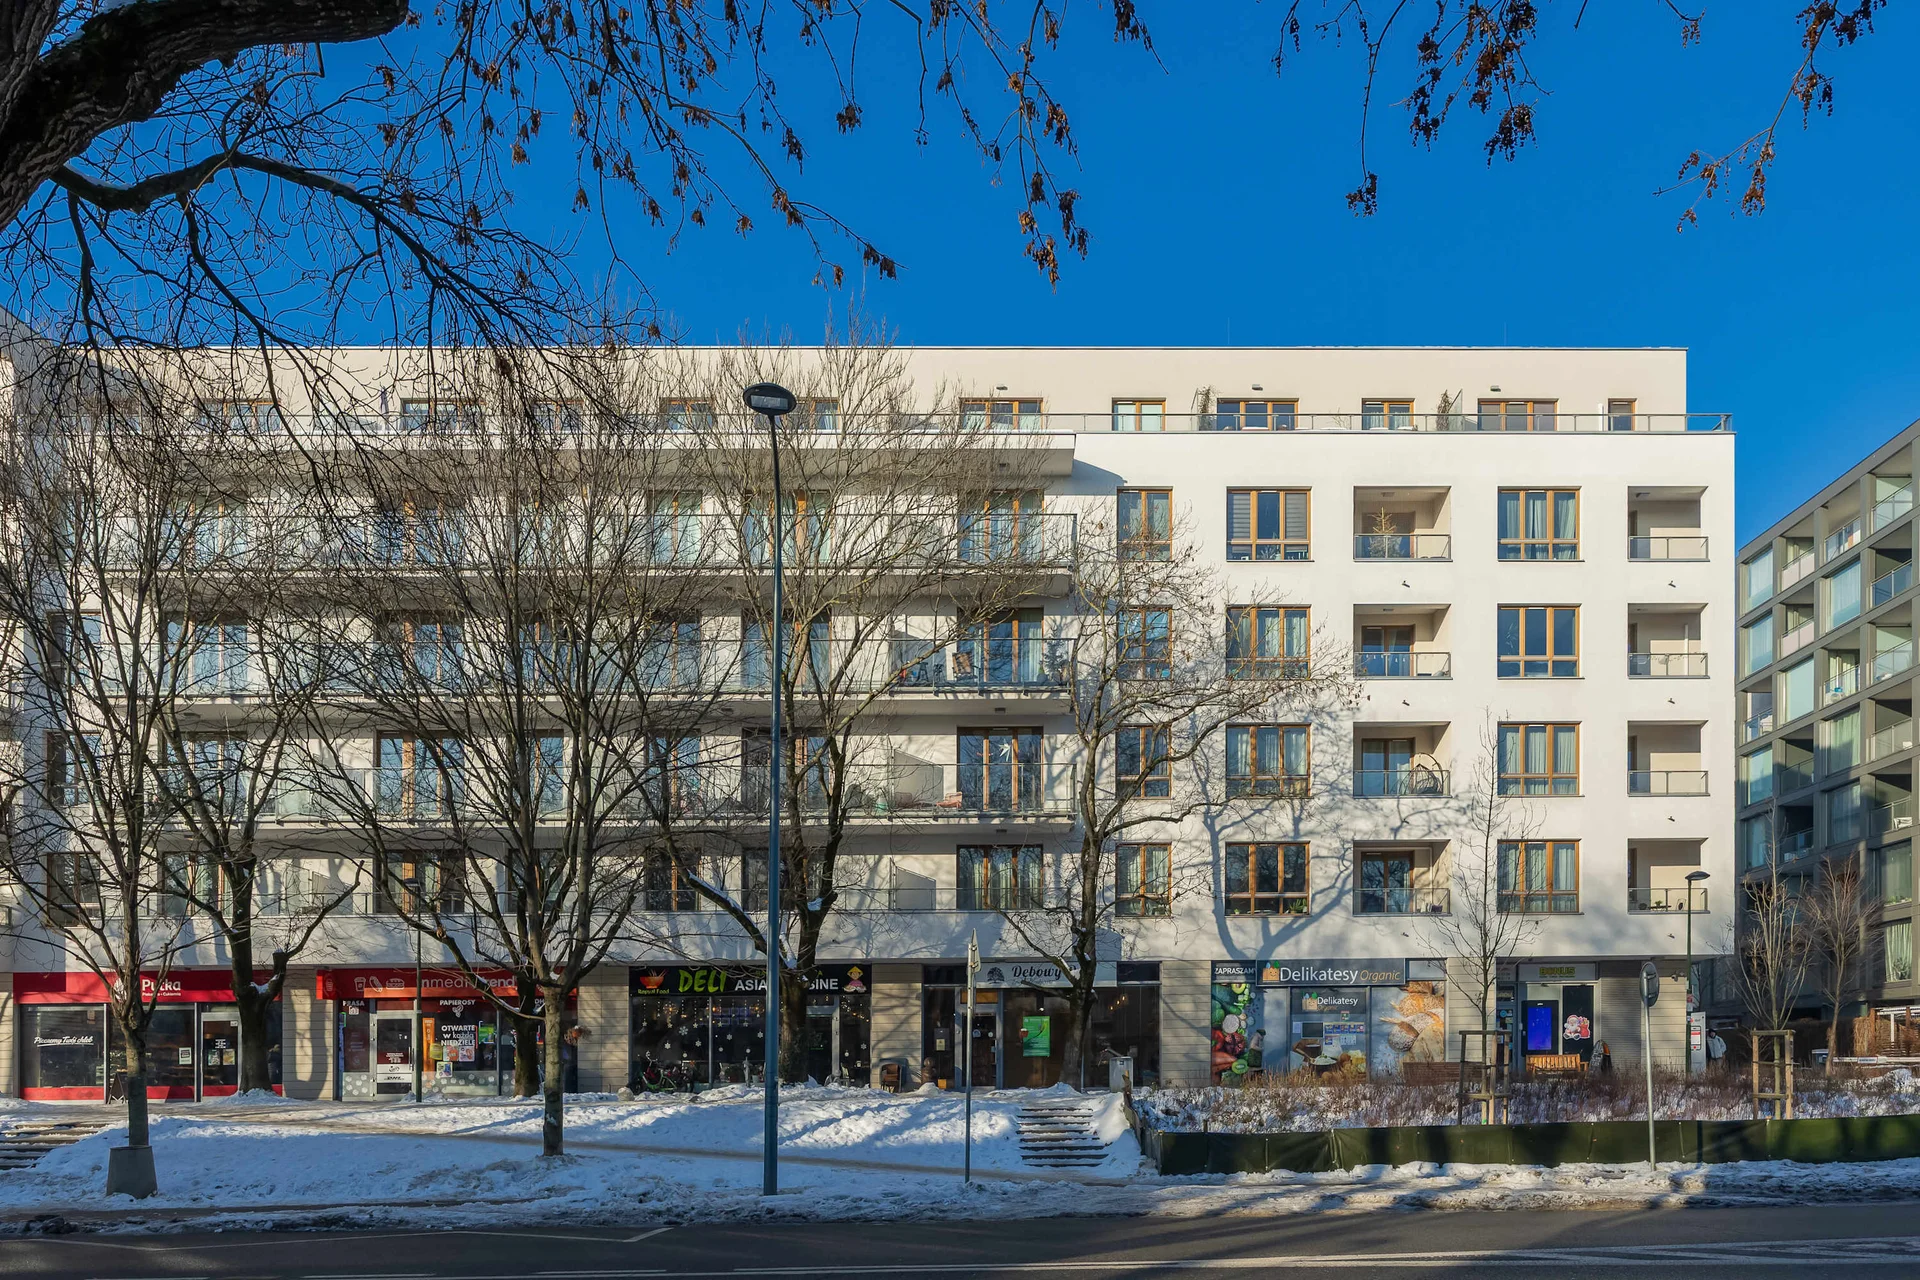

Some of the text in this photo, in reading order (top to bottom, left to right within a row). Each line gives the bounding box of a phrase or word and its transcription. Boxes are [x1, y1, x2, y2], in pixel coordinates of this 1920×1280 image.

[678, 969, 727, 993] DELI
[1280, 966, 1400, 984] Delikatesy Organic
[734, 979, 769, 991] ASIA
[1317, 996, 1358, 1006] Delikatesy
[441, 1024, 475, 1032] OTWARTE
